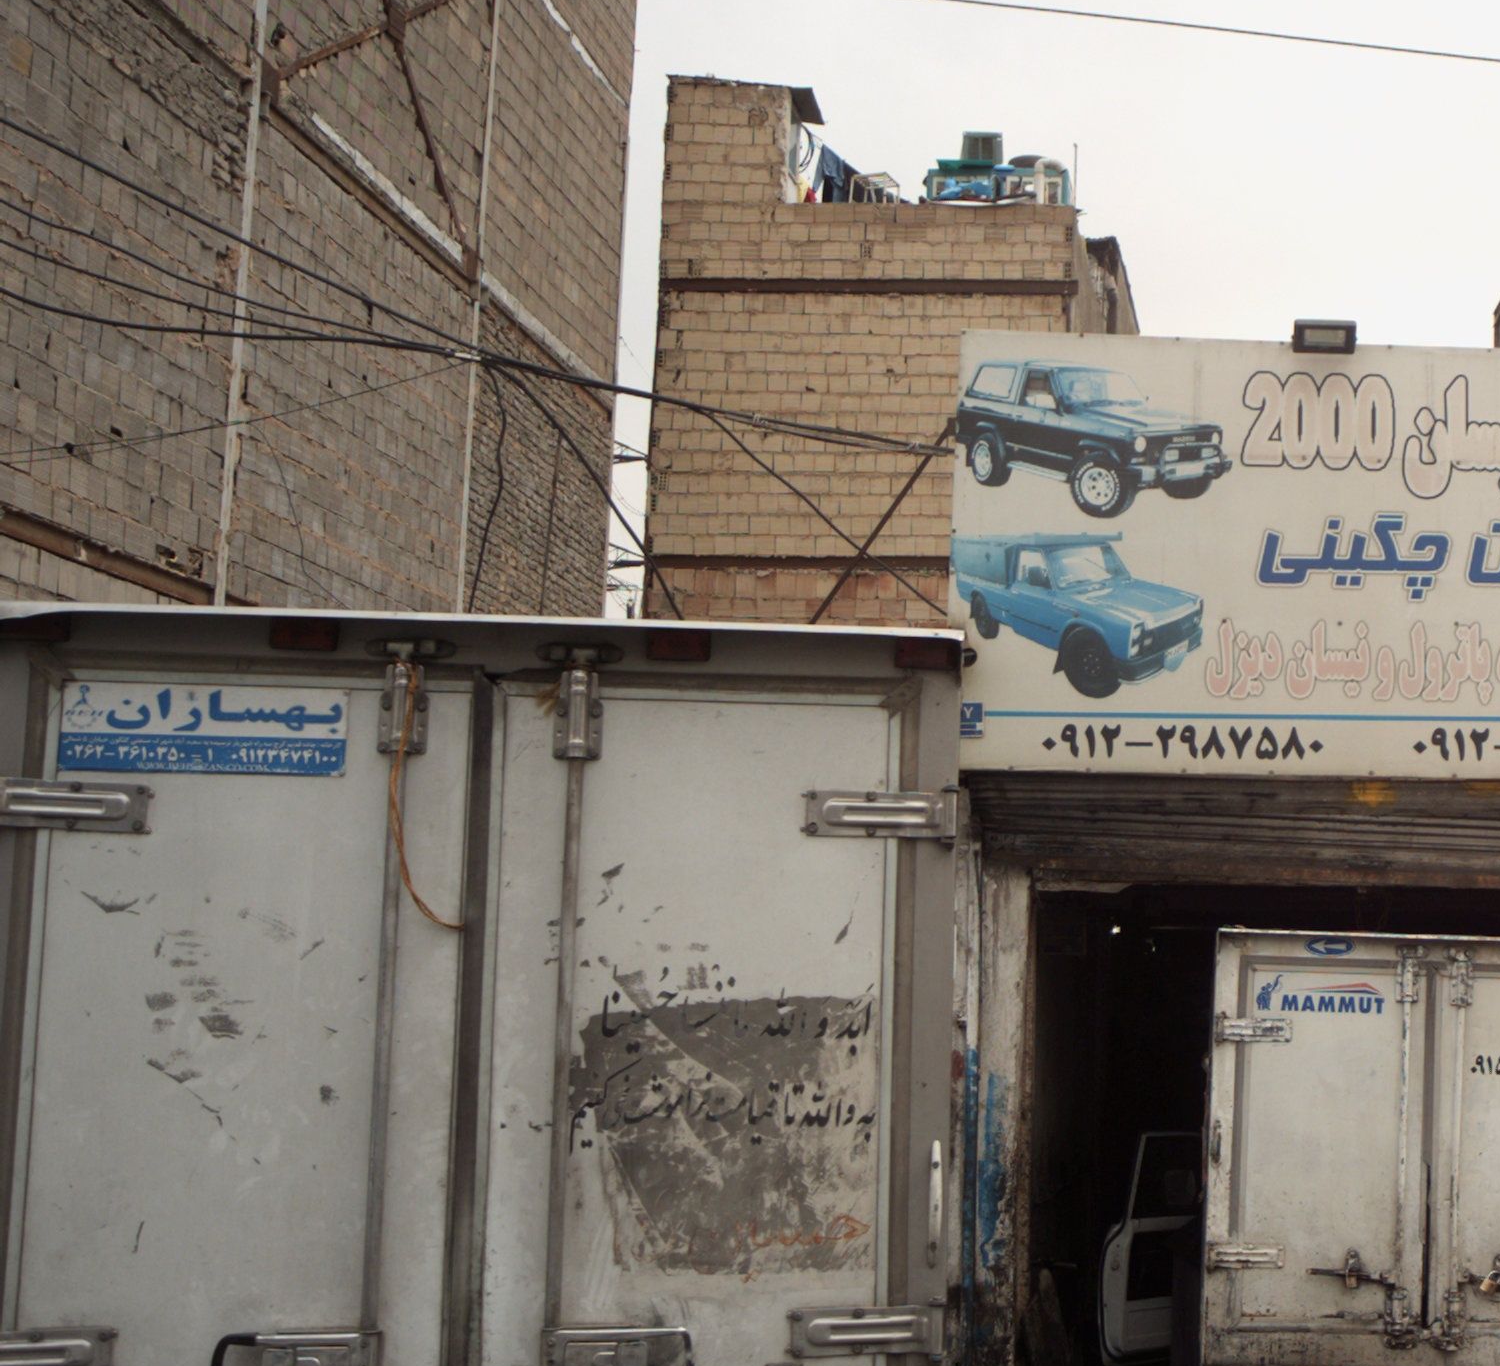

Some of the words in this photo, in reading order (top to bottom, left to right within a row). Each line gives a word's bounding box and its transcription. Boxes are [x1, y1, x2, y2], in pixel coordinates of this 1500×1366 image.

[1242, 371, 1394, 470] 2000
[1257, 510, 1450, 602] چگینی
[1206, 618, 1283, 699] دیزل
[1285, 619, 1370, 699] نیسان
[1372, 645, 1395, 701] و
[1400, 620, 1493, 706] پاترول
[105, 688, 343, 735] بهسازان
[1041, 722, 1324, 761] ۰۹۱۲-۲۹۸۷۵۸۰
[1281, 993, 1385, 1014] MAMMUT
